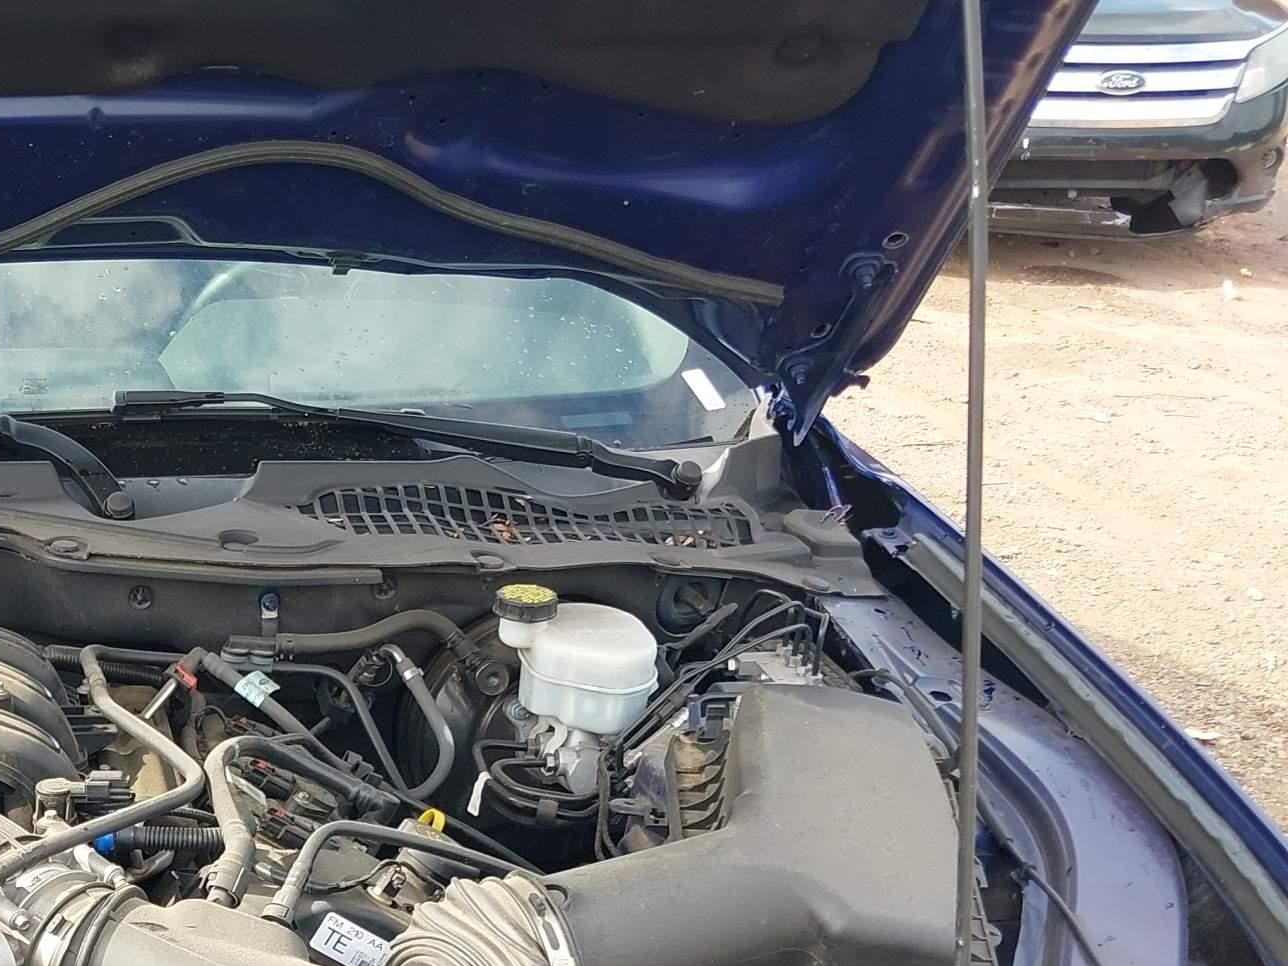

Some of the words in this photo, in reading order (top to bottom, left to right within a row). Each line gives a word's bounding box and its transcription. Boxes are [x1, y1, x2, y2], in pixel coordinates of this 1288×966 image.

[1103, 74, 1139, 89] Ford
[323, 926, 353, 955] TE
[327, 915, 345, 930] FM
[367, 939, 384, 951] AA
